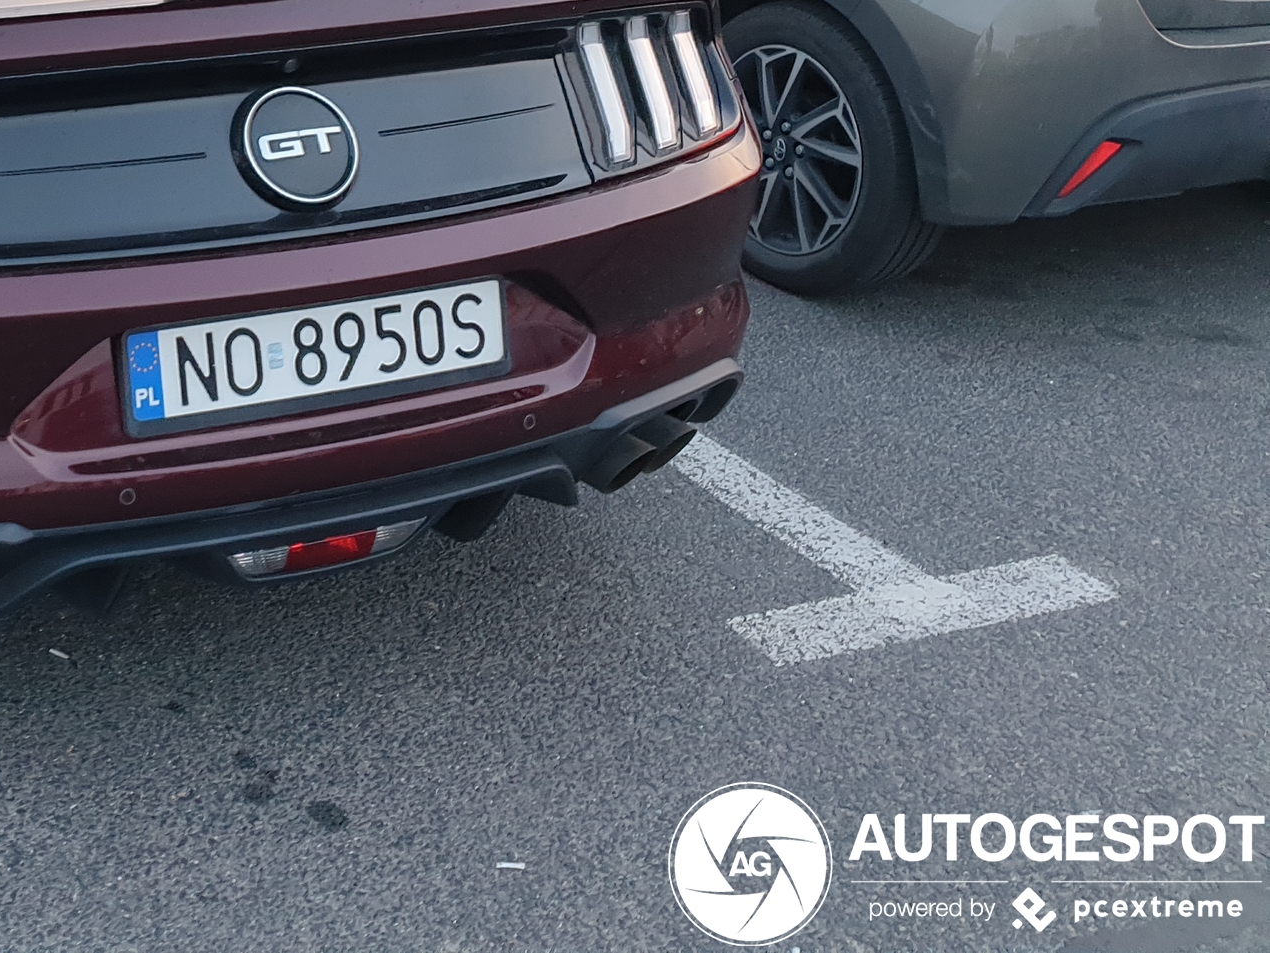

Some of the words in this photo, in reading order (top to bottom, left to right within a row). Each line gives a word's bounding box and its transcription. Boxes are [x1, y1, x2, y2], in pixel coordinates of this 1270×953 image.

[258, 125, 342, 161] GT
[135, 388, 160, 409] PL
[176, 327, 264, 406] NO
[292, 293, 486, 386] 8950S
